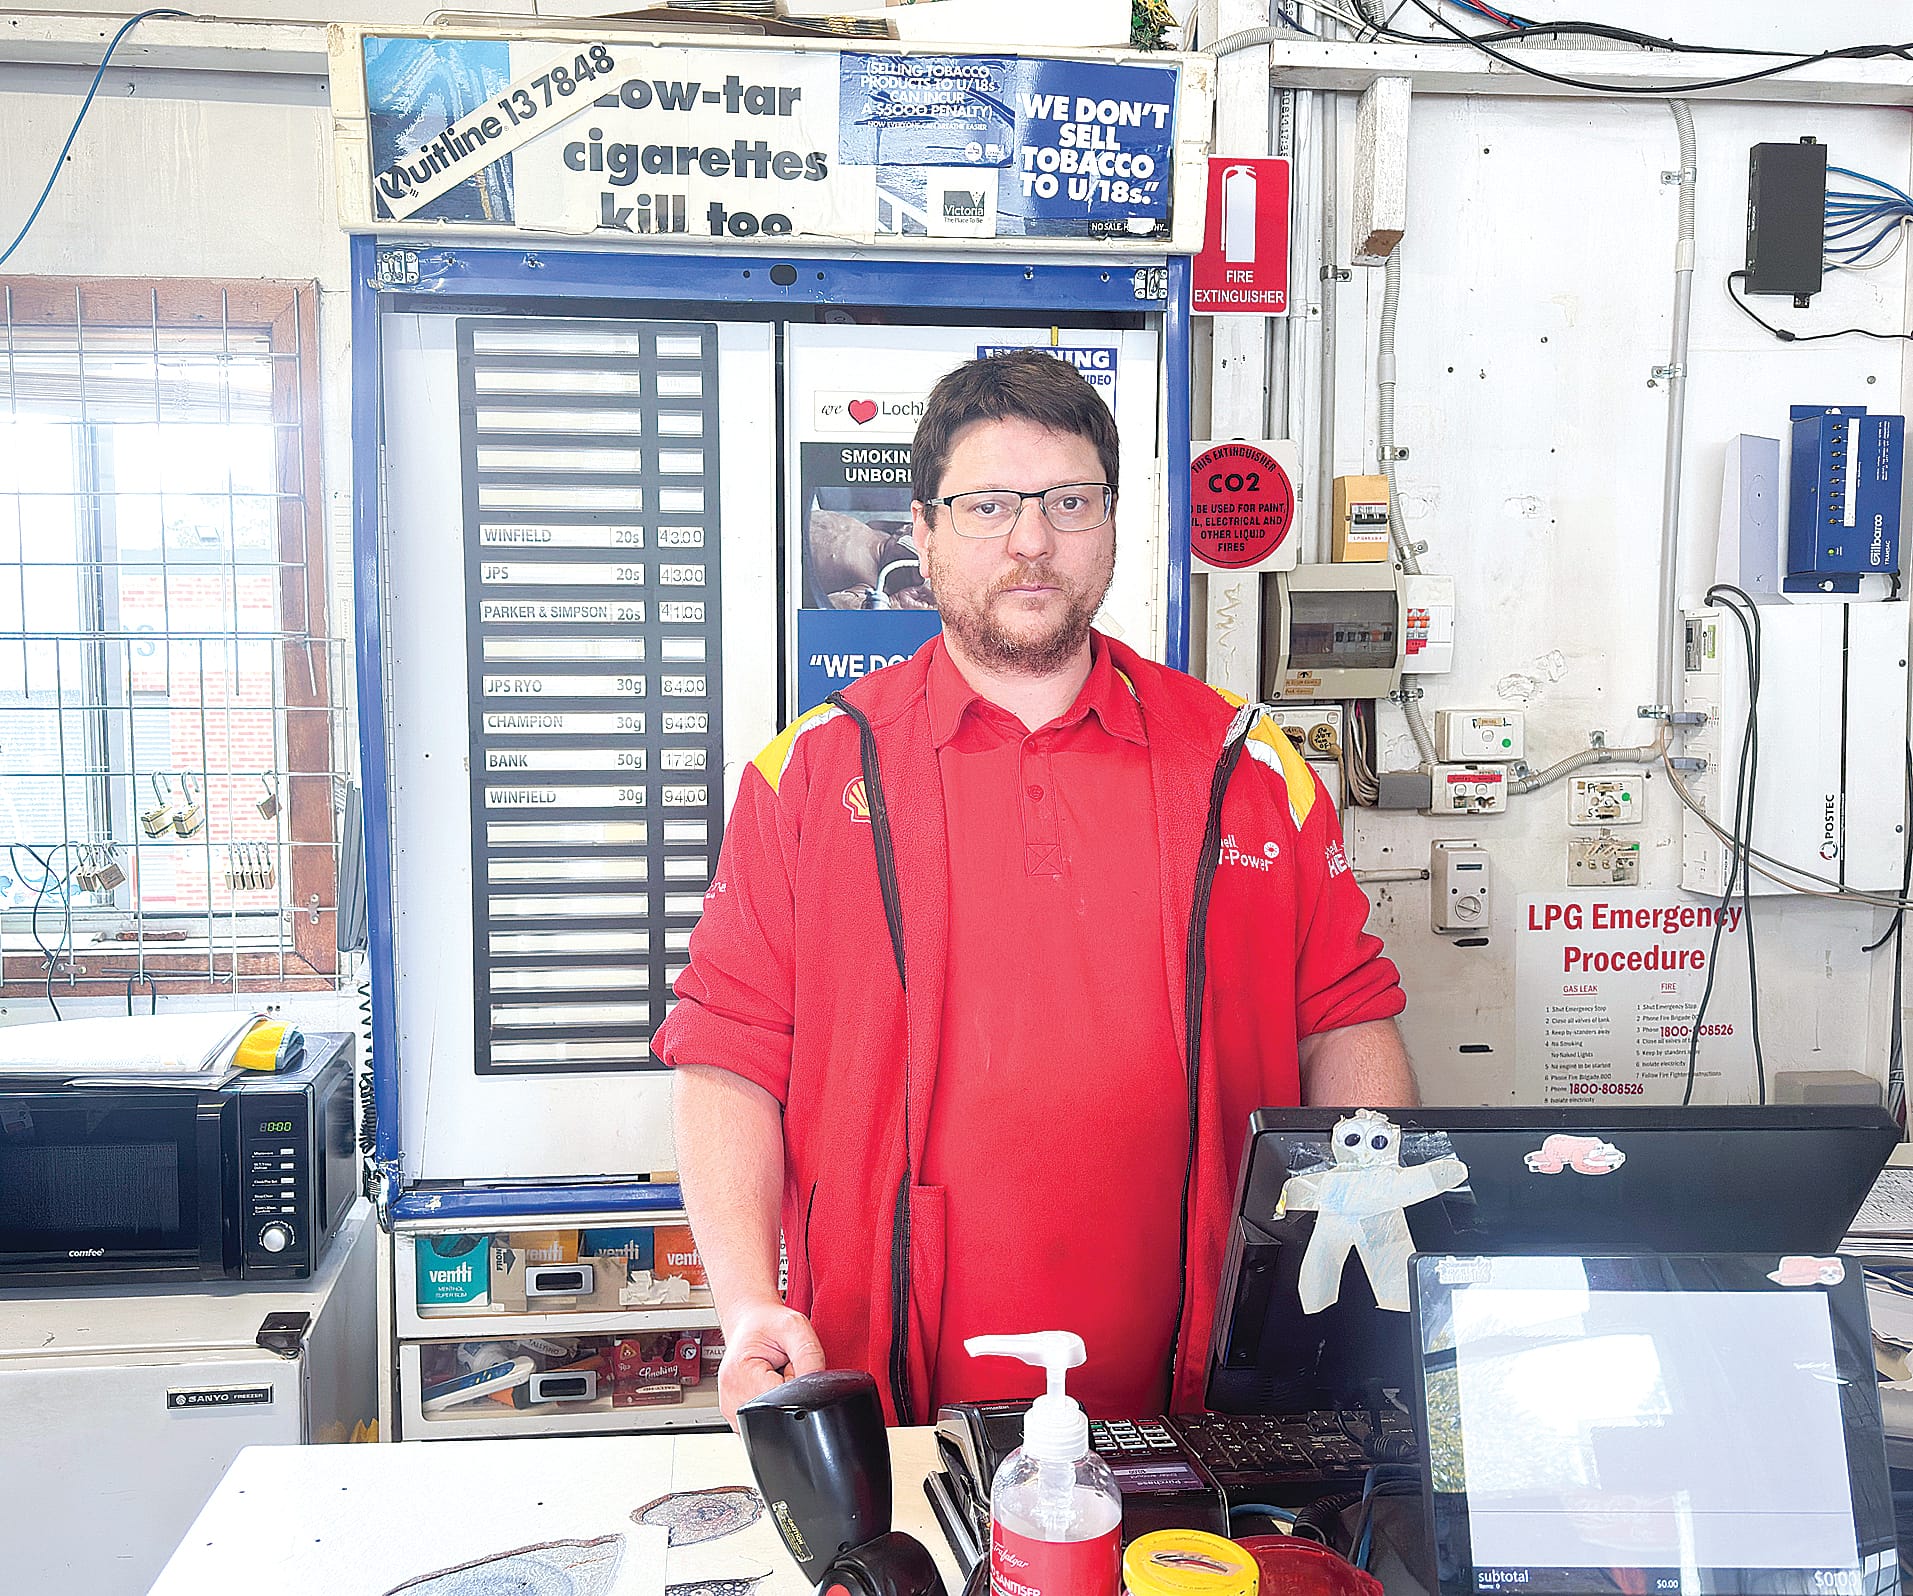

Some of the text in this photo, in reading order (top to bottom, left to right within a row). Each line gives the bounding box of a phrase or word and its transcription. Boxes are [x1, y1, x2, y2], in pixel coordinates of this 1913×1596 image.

[867, 62, 990, 79] (SELLING TOBACCO
[861, 76, 931, 90] PRODUCTS
[934, 78, 954, 91] TO
[594, 76, 802, 116] ow-tar
[890, 90, 965, 104] CAN INCUR
[861, 102, 993, 120] A $5000 PENALTY)
[1075, 97, 1170, 129] DON'T
[378, 43, 616, 199] Quitline 13 7848
[966, 123, 988, 131] EASIER
[1058, 122, 1121, 151] SELL
[563, 127, 828, 187] cigarettes
[1021, 145, 1155, 179] TOBACCO
[1019, 171, 1059, 199] TO
[601, 192, 793, 236] kill too
[944, 204, 985, 217] Victoria
[1091, 222, 1104, 231] NO
[1226, 270, 1254, 283] FIRE
[1194, 289, 1285, 304] EXTINGUISHER
[841, 447, 911, 464] SMOKIN
[1191, 447, 1277, 474] THIS EXTINGUISHER
[1208, 472, 1261, 493] CO2
[1196, 502, 1287, 514] BE USED FOR PAINT,
[1205, 515, 1283, 527] ELECTRICAL AND
[484, 528, 552, 543] WINFIELD
[615, 530, 640, 544] 20s
[1200, 529, 1266, 540] OTHER LIQUID
[1870, 514, 1883, 566] Gilbarco
[1217, 542, 1246, 552] FIRES
[485, 566, 509, 580] JPS
[616, 567, 640, 582] 20s
[484, 605, 535, 619] PARKER
[538, 606, 548, 619] &
[550, 605, 607, 619] SIMPSON
[617, 607, 641, 621] 20s
[487, 679, 511, 693] JPS
[514, 679, 542, 693] RYO
[616, 678, 642, 694] 30g
[487, 715, 563, 729] CHAMPION
[616, 716, 642, 731] 30g
[489, 754, 529, 768] BANK
[617, 753, 642, 768] 50g
[490, 789, 557, 804] WINFIELD
[618, 789, 643, 805] 30g
[1824, 794, 1835, 840] POSTEC
[1528, 903, 1583, 931] LPG
[1563, 944, 1706, 973] Procedure
[1563, 984, 1598, 994] GAS LEAK
[1661, 983, 1677, 991] FIRE
[1660, 1024, 1733, 1037] 1800-08526
[495, 1247, 504, 1271] FRON
[429, 1261, 473, 1283] ventti
[638, 1364, 678, 1380] Smoking
[188, 1392, 263, 1403] SANYO FREEZER
[993, 1541, 1029, 1568] Trafalgar
[1478, 1569, 1529, 1583] subtotal
[1656, 1579, 1679, 1589] $0.00
